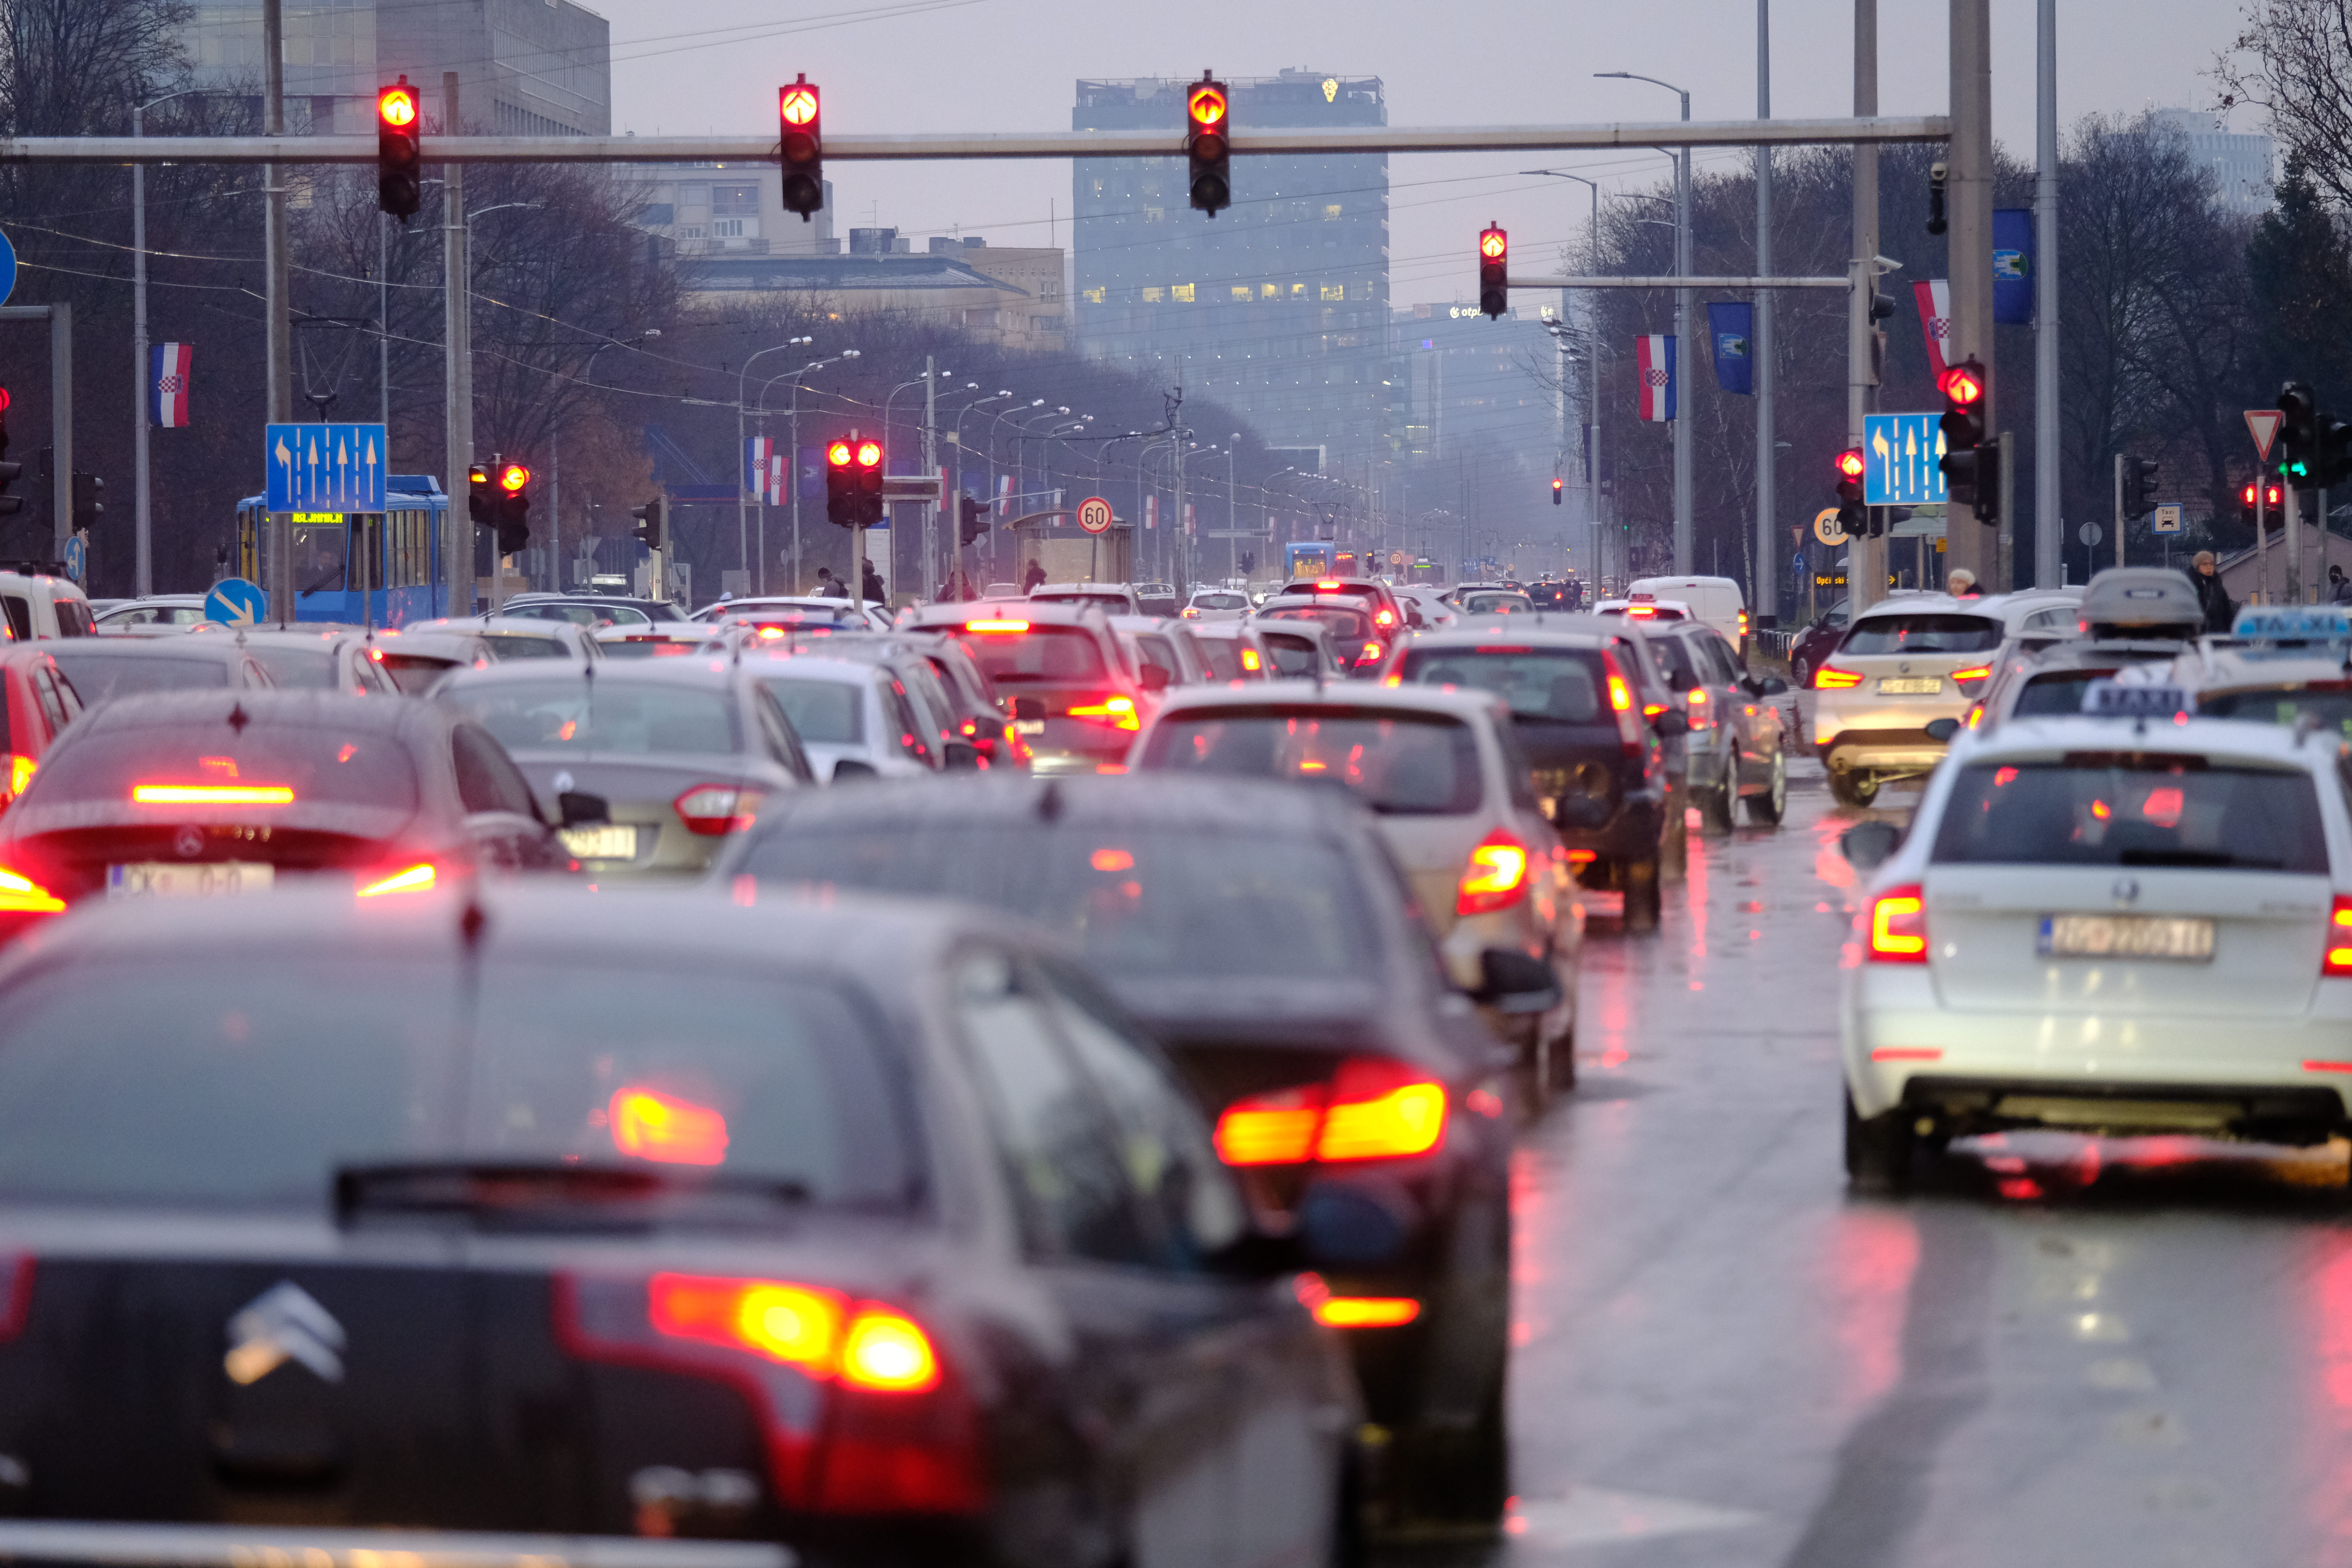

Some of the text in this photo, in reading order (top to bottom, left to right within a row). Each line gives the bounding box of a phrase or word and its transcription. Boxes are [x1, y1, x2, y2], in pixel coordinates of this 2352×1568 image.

[1085, 507, 1104, 524] 60
[1823, 518, 1842, 536] 60
[1817, 577, 1844, 586] Općiski
